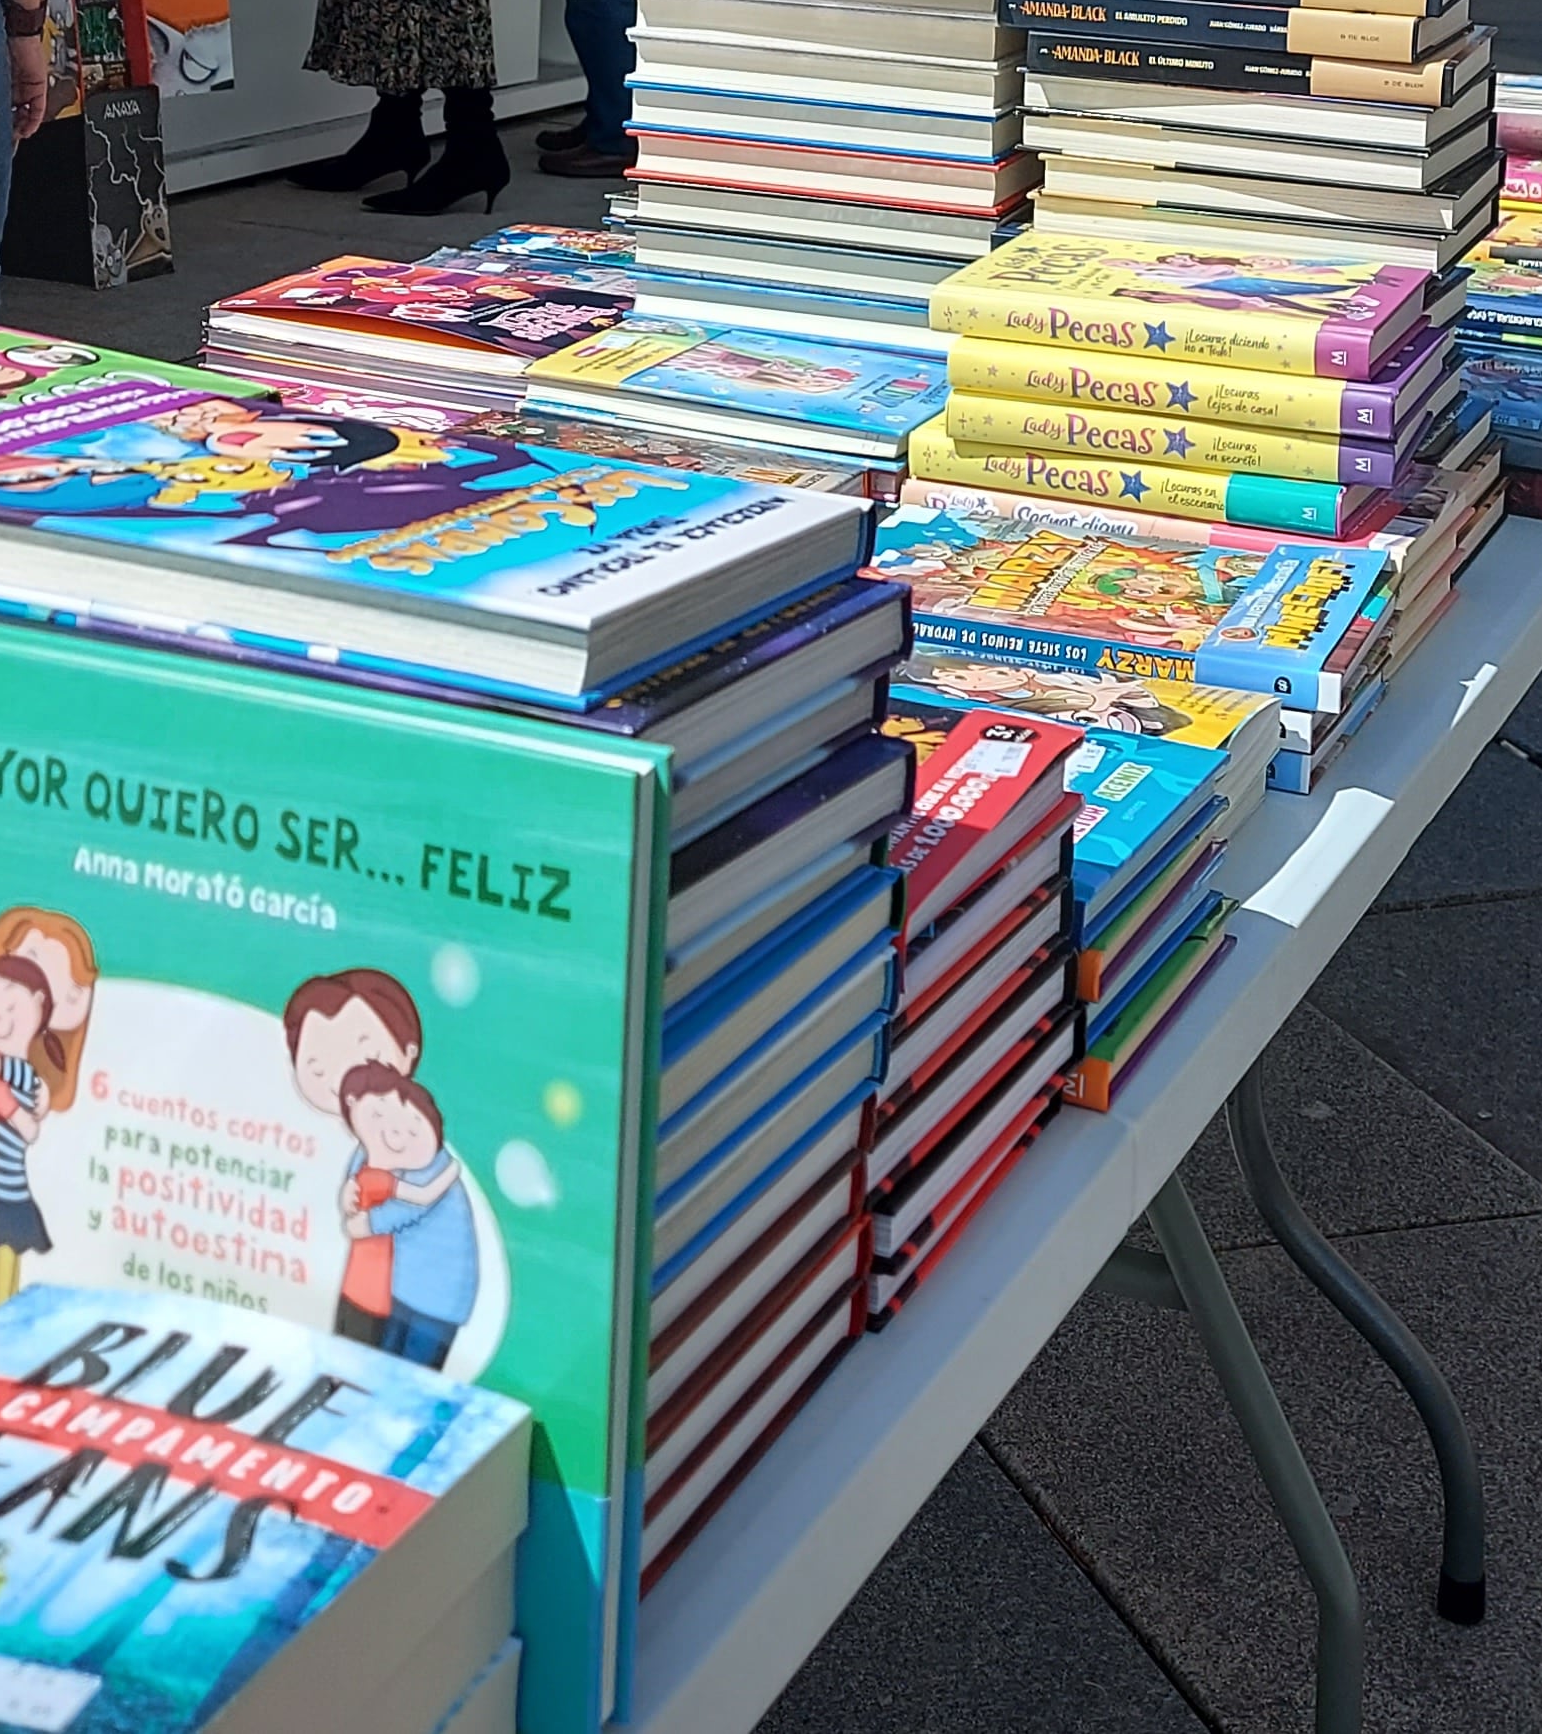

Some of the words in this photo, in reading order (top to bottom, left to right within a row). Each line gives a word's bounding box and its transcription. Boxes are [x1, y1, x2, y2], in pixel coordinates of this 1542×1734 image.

[1019, 0, 1070, 19] AMANDA
[1072, 4, 1107, 24] BLACK
[1115, 11, 1124, 22] EL
[1126, 12, 1155, 25] AMULETO
[1157, 13, 1188, 26] PERDIDO
[1051, 43, 1101, 65] AMANDA
[1104, 47, 1140, 67] BLACK
[1149, 55, 1158, 66] EL
[103, 99, 141, 120] ANAYA
[988, 243, 1109, 285] Pecas
[1006, 309, 1045, 333] Lady
[1047, 307, 1136, 349] Pecas
[1185, 329, 1227, 345] ¡Locuras
[1229, 336, 1270, 350] diciendo
[1025, 370, 1067, 393] Lady
[1069, 367, 1159, 407] Pecas
[1207, 396, 1232, 413] lejos
[1234, 401, 1247, 413] de
[1249, 404, 1278, 417] casa!
[1215, 385, 1260, 401] ¡Locuras
[1020, 416, 1063, 439] Lady
[1066, 413, 1156, 454] Pecas
[1212, 438, 1257, 454] ¡Locuras
[983, 454, 1025, 479] Lady
[1025, 452, 1113, 497] Pecas
[1219, 453, 1261, 467] secreto!
[1161, 478, 1201, 496] ¡Locuras
[965, 530, 1085, 612] MARZY
[961, 629, 976, 645] DE
[981, 632, 1024, 652] REINOS
[1028, 638, 1061, 658] SIETE
[1066, 644, 1087, 662] LOS
[1096, 646, 1195, 684] MARZY
[84, 769, 258, 852] QUIERO
[275, 810, 405, 887] SER...
[419, 843, 573, 922] FELIZ
[73, 845, 139, 885] Anna
[143, 858, 245, 911] Morató
[248, 880, 338, 932] García
[89, 1069, 109, 1101] 6
[117, 1084, 218, 1132] cuentos
[227, 1114, 316, 1158] cortos
[104, 1122, 161, 1156] para
[169, 1139, 295, 1193] potenciar
[89, 1156, 110, 1186] la
[116, 1163, 309, 1242] positividad
[88, 1207, 101, 1232] y
[112, 1203, 308, 1284] autoestima
[123, 1252, 149, 1283] de
[159, 1256, 194, 1295] los
[203, 1276, 268, 1315] niños
[17, 1319, 374, 1450] BLUE
[0, 1392, 374, 1516] CAMPAMENTO
